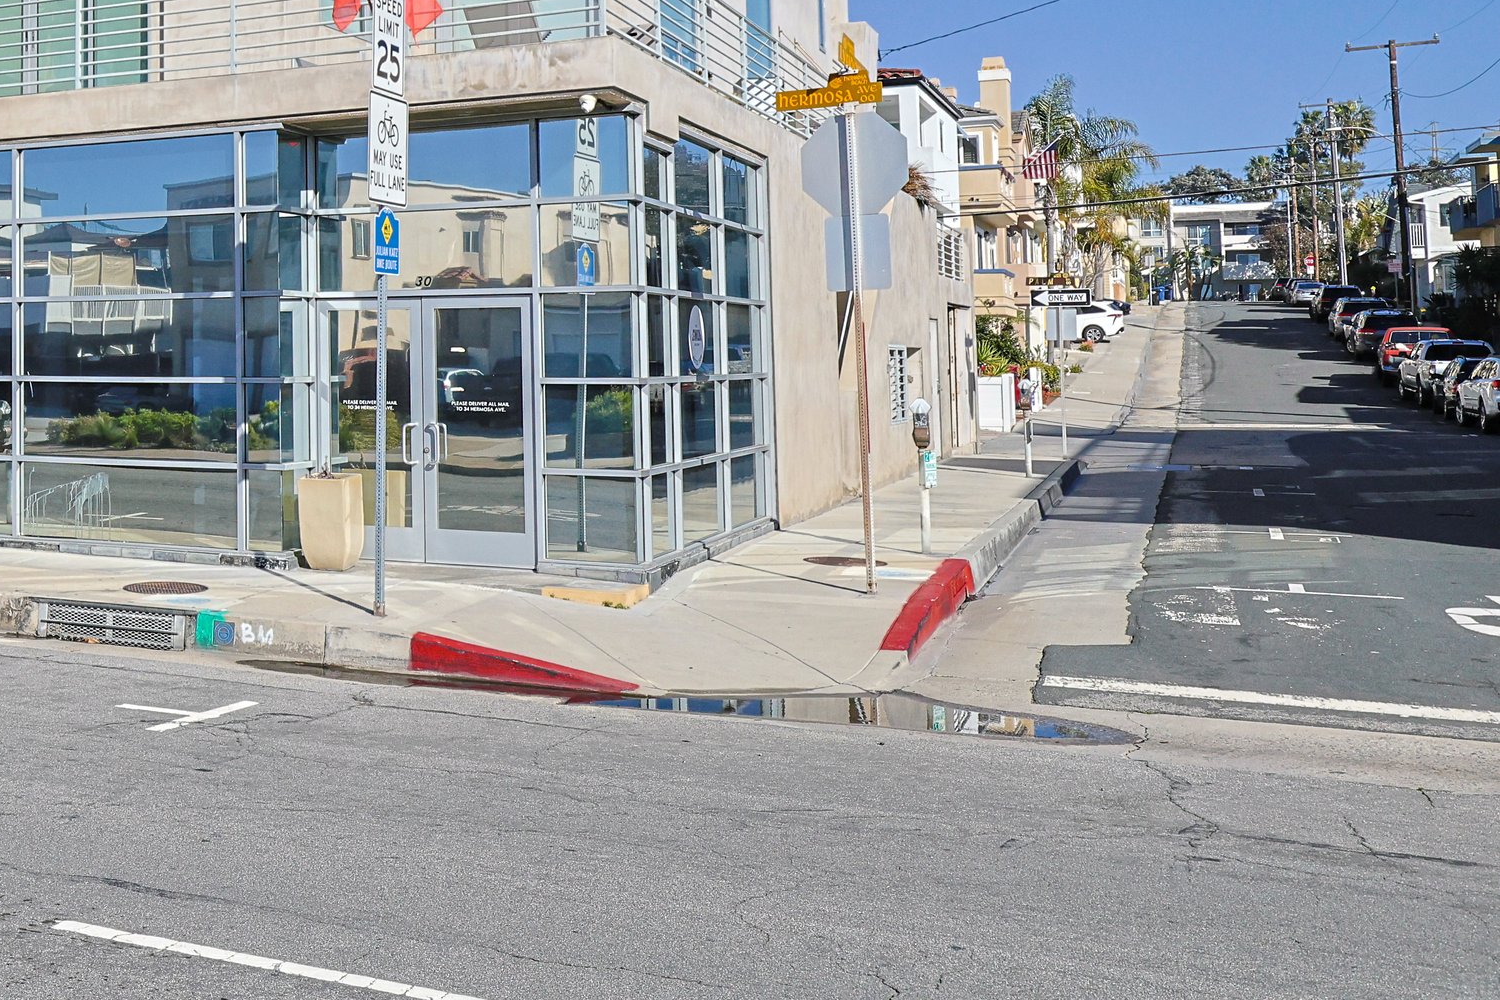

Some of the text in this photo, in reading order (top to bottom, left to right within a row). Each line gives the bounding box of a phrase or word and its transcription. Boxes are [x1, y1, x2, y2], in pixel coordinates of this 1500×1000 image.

[379, 16, 399, 38] LIMIT
[377, 39, 400, 83] 25
[373, 149, 402, 170] MAY USE
[370, 170, 405, 192] FULL LANE
[415, 275, 432, 287] 30
[1047, 294, 1065, 302] ONE
